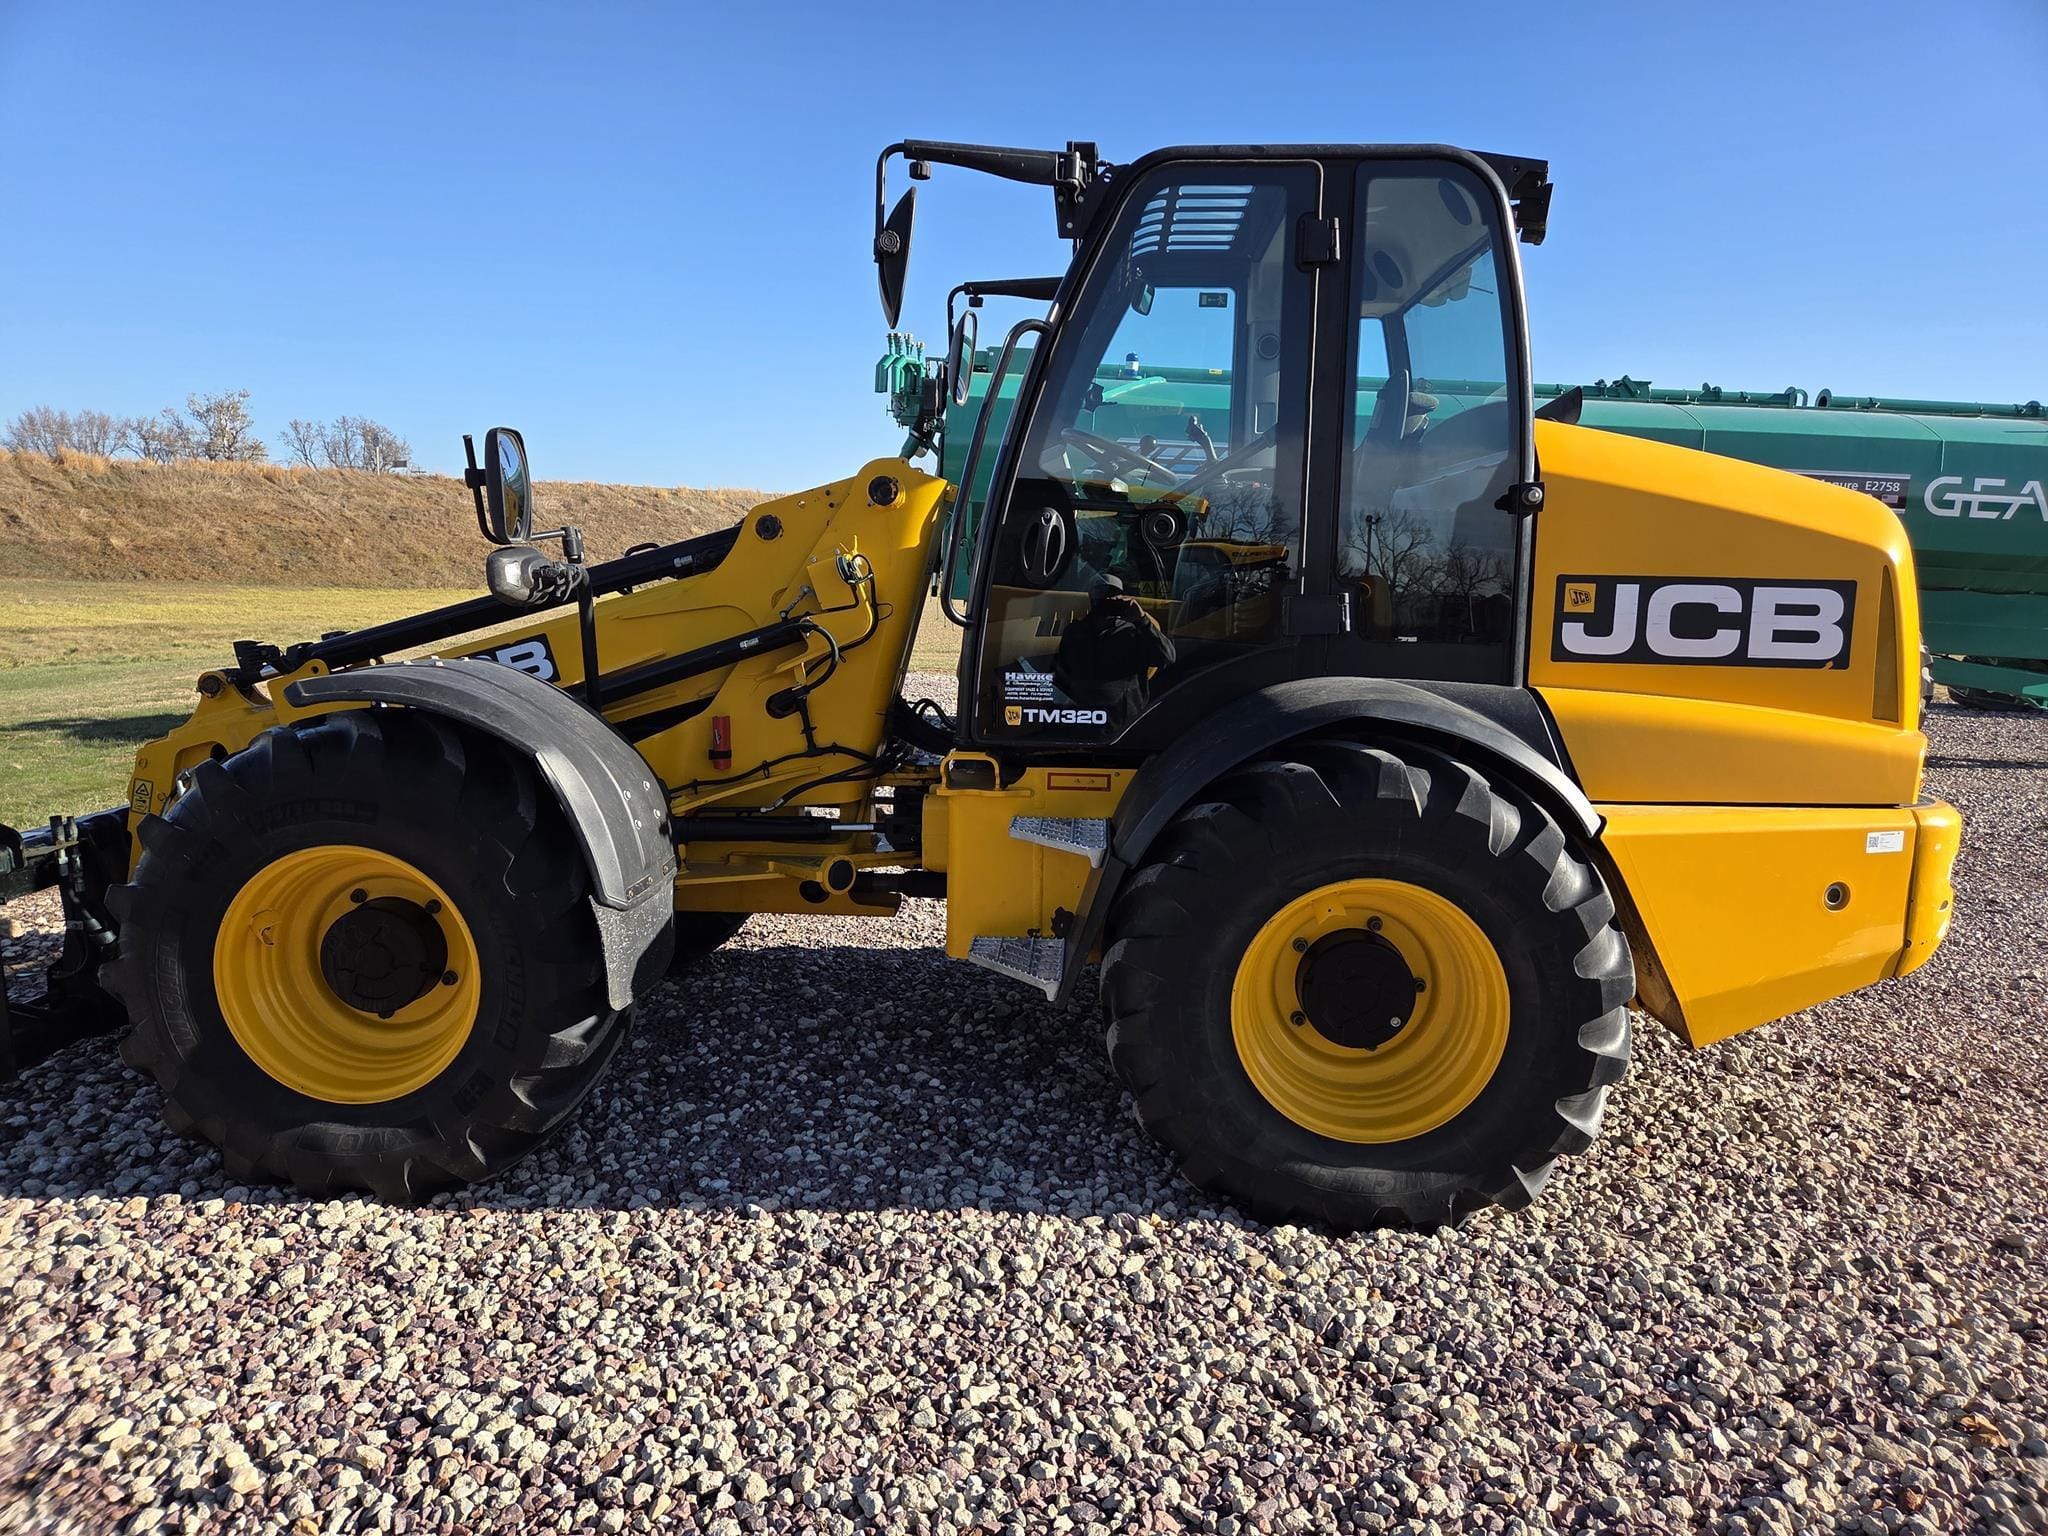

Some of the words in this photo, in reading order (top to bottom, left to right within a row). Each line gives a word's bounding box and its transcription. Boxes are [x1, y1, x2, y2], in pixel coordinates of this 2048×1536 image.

[1865, 480, 1901, 492] E2758
[1924, 475, 2048, 521] GEA
[1572, 591, 1590, 605] JCB
[1561, 583, 1845, 661] JCB
[1005, 672, 1054, 681] Hawke
[1023, 708, 1107, 724] TM320
